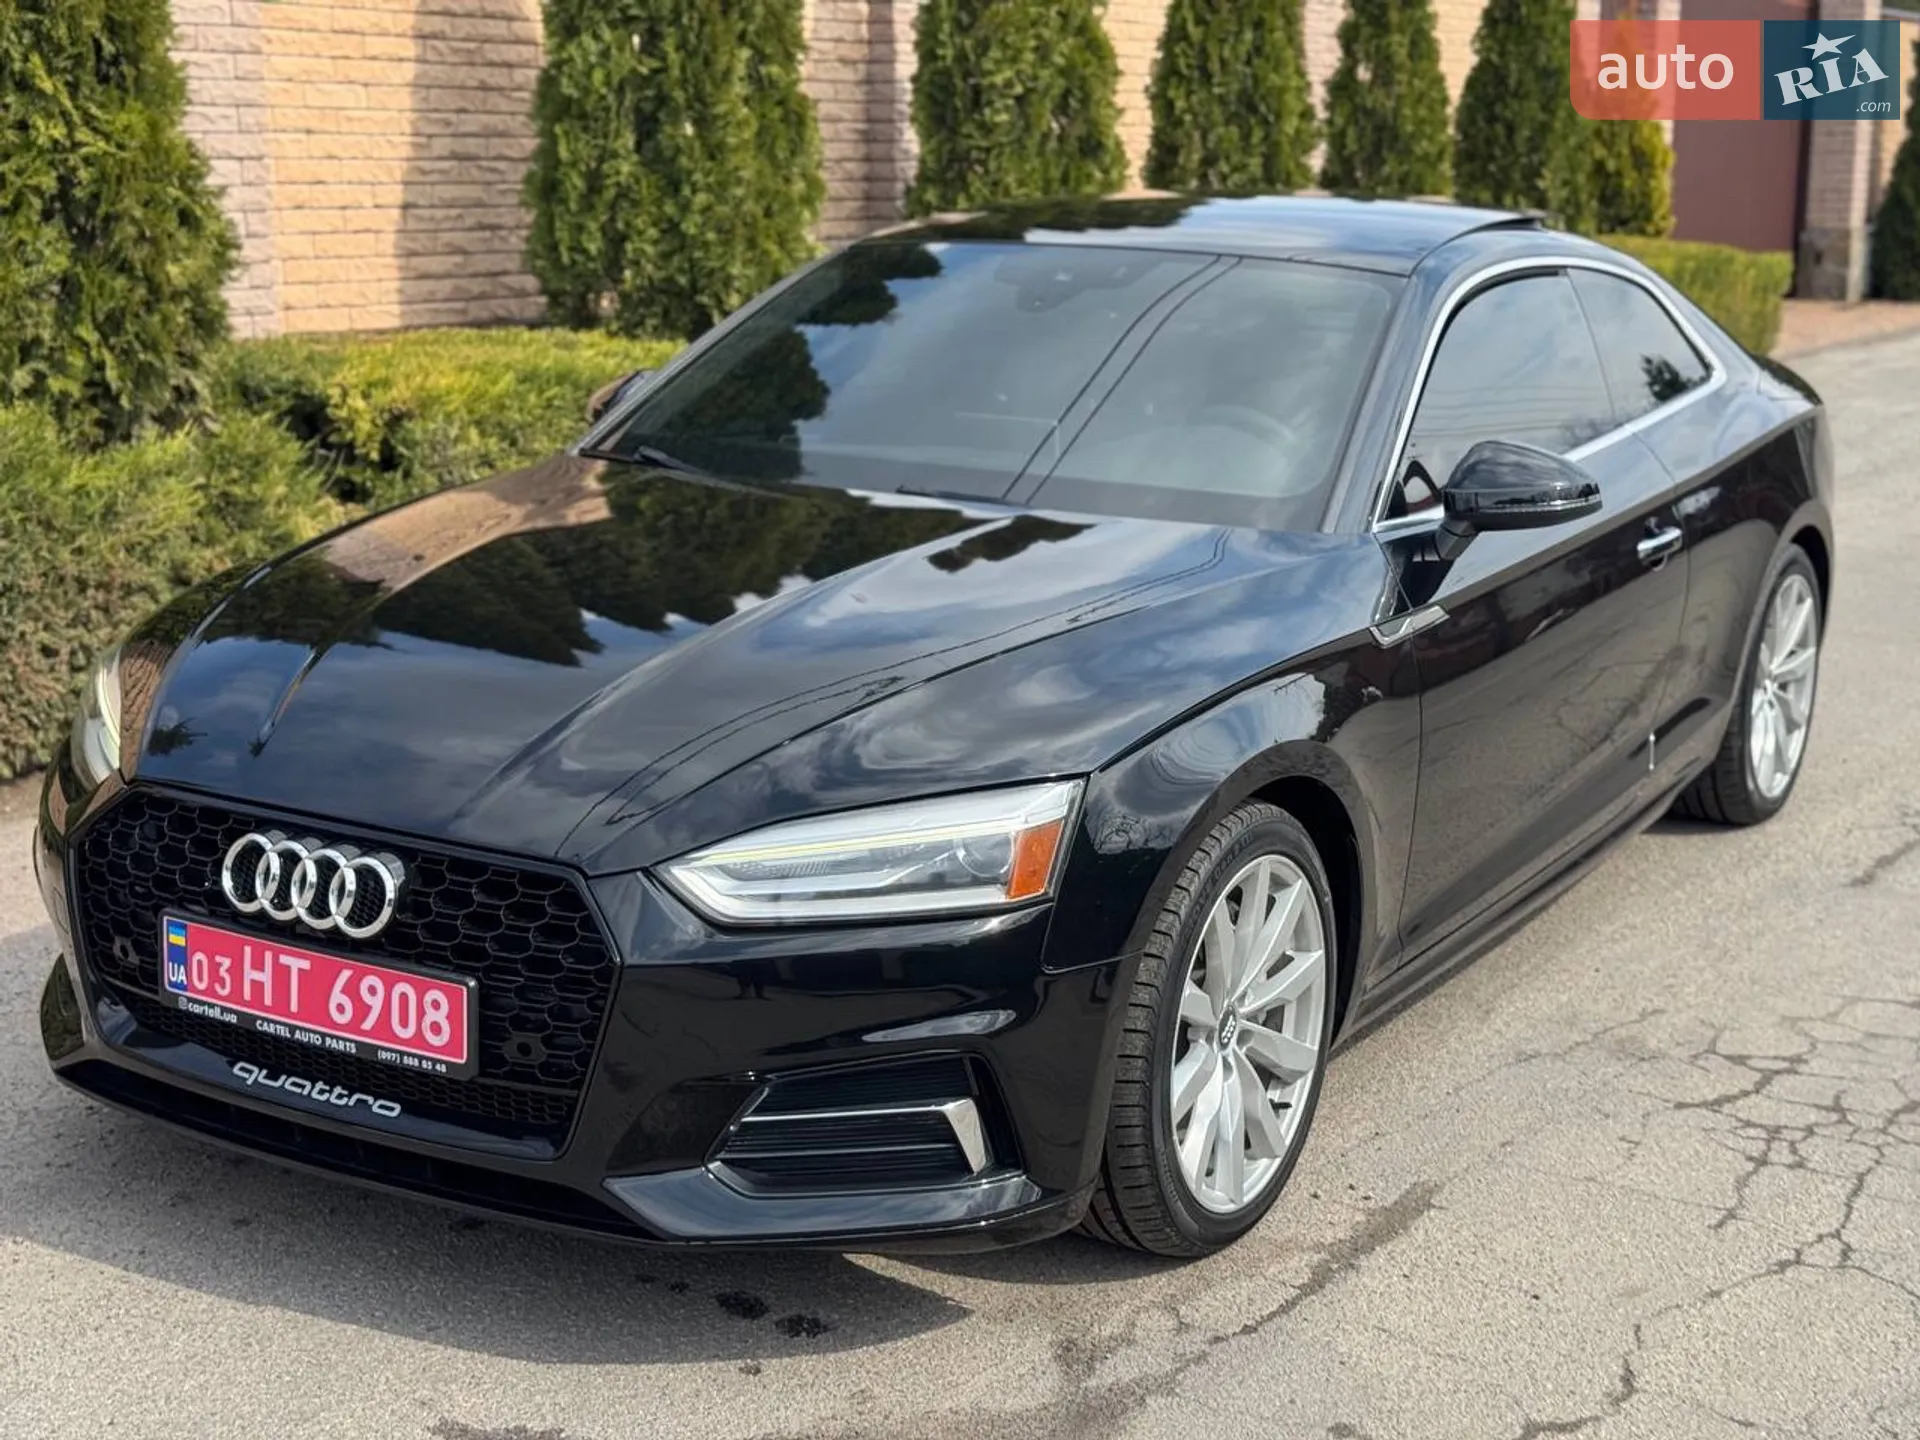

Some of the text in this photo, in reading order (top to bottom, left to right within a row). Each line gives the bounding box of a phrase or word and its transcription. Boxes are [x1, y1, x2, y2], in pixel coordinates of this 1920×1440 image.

[168, 961, 187, 985] UA
[191, 945, 451, 1047] 03 HT 6908
[255, 1019, 357, 1054] CARTEL AUTO PARTS
[232, 1060, 402, 1118] quattro
